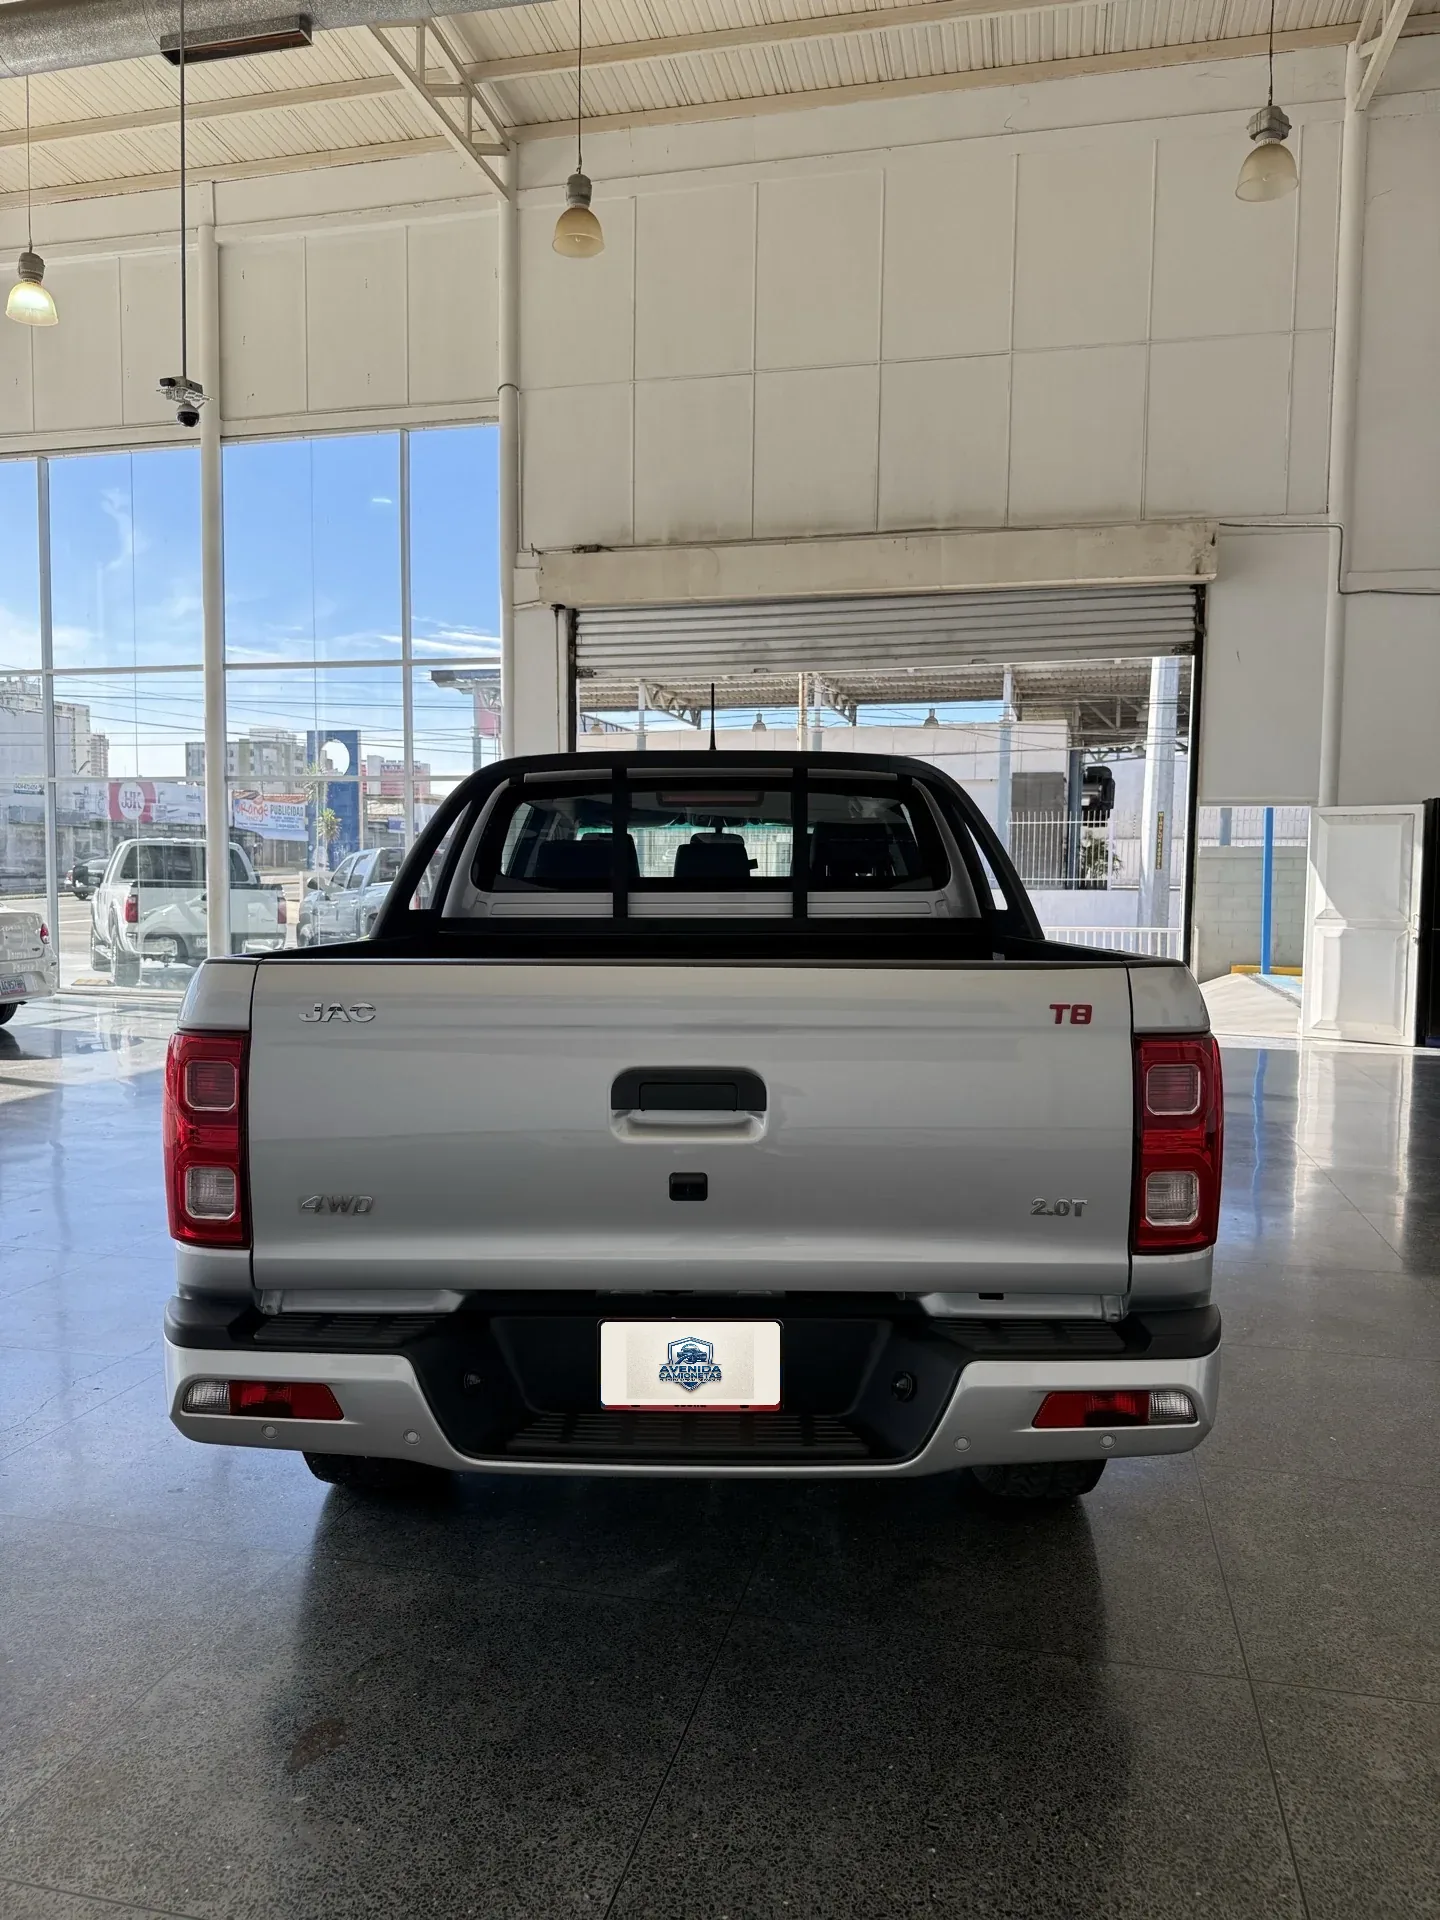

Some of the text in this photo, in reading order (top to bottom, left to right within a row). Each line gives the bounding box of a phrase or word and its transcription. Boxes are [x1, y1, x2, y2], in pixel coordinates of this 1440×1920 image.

[270, 804, 304, 816] PUBLICIDAD
[299, 1002, 376, 1022] JAC
[1050, 1004, 1092, 1024] T8
[301, 1195, 373, 1215] 4WD
[1031, 1197, 1088, 1216] 2.0T
